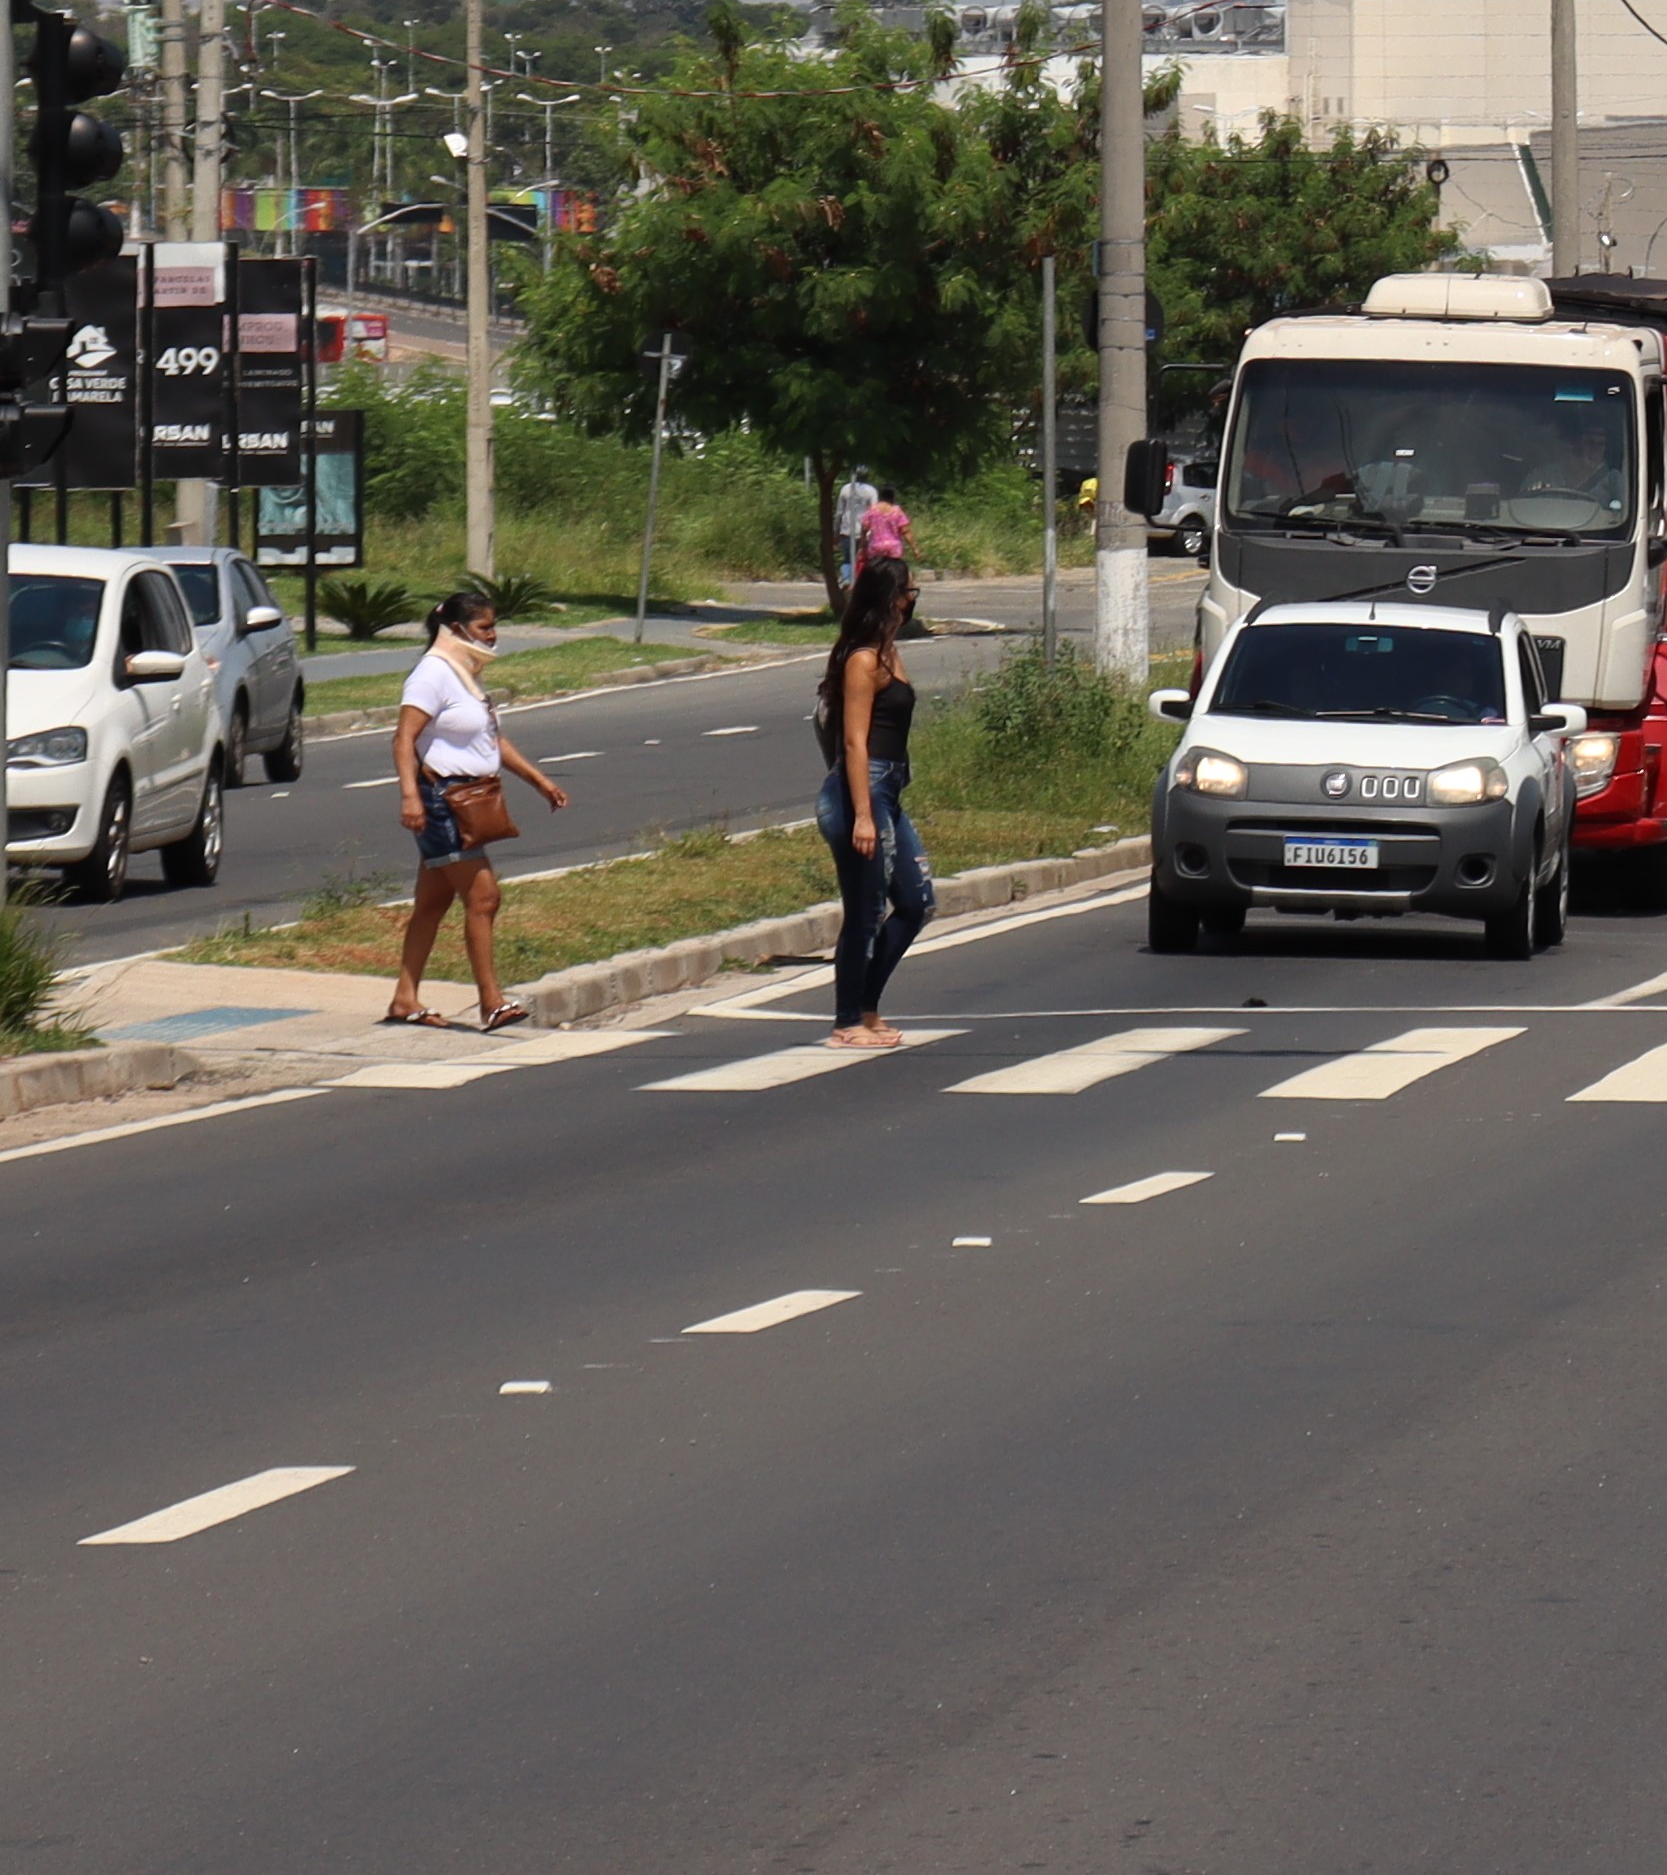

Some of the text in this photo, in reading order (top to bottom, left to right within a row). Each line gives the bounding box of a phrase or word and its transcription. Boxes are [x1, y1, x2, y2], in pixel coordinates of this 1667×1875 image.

[155, 347, 220, 376] 499
[86, 376, 128, 390] VERDE
[1293, 846, 1369, 865] FIU6I56
